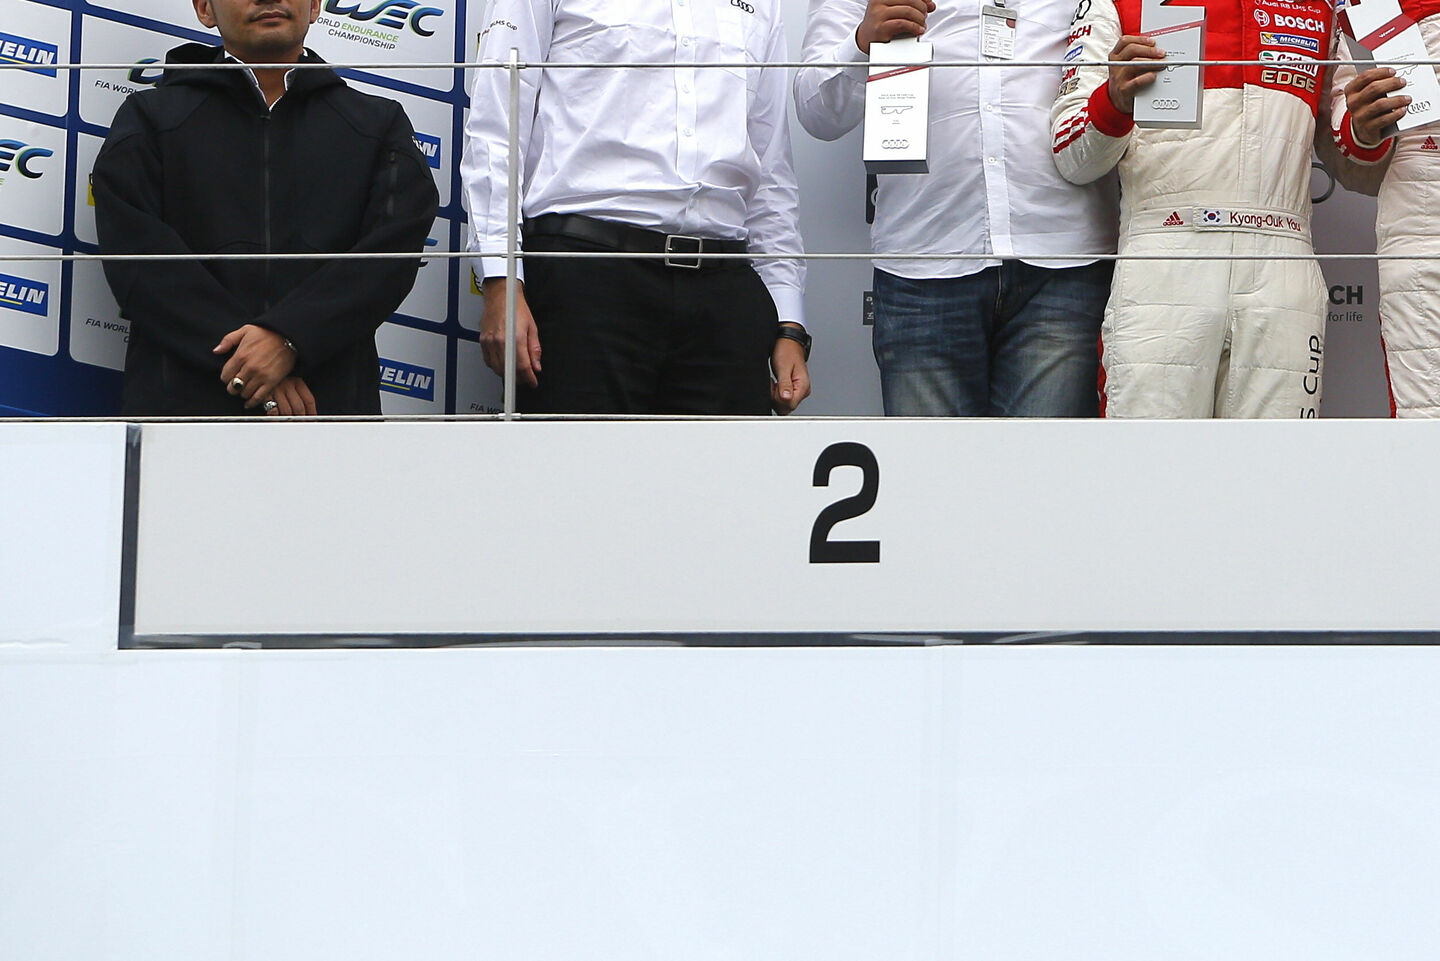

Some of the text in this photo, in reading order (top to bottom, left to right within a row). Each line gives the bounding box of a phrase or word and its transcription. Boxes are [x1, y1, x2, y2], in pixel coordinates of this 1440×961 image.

[342, 23, 398, 43] ENDURANCE
[1274, 13, 1325, 33] BOSCH
[328, 28, 396, 50] CHAMPIONSHIP
[1280, 35, 1317, 48] MICHELIN
[1261, 69, 1317, 93] EDGE
[1229, 211, 1284, 228] Kyong-Ouk
[1328, 311, 1362, 321] for life
[1303, 335, 1322, 395] Cup
[809, 442, 880, 564] 2
